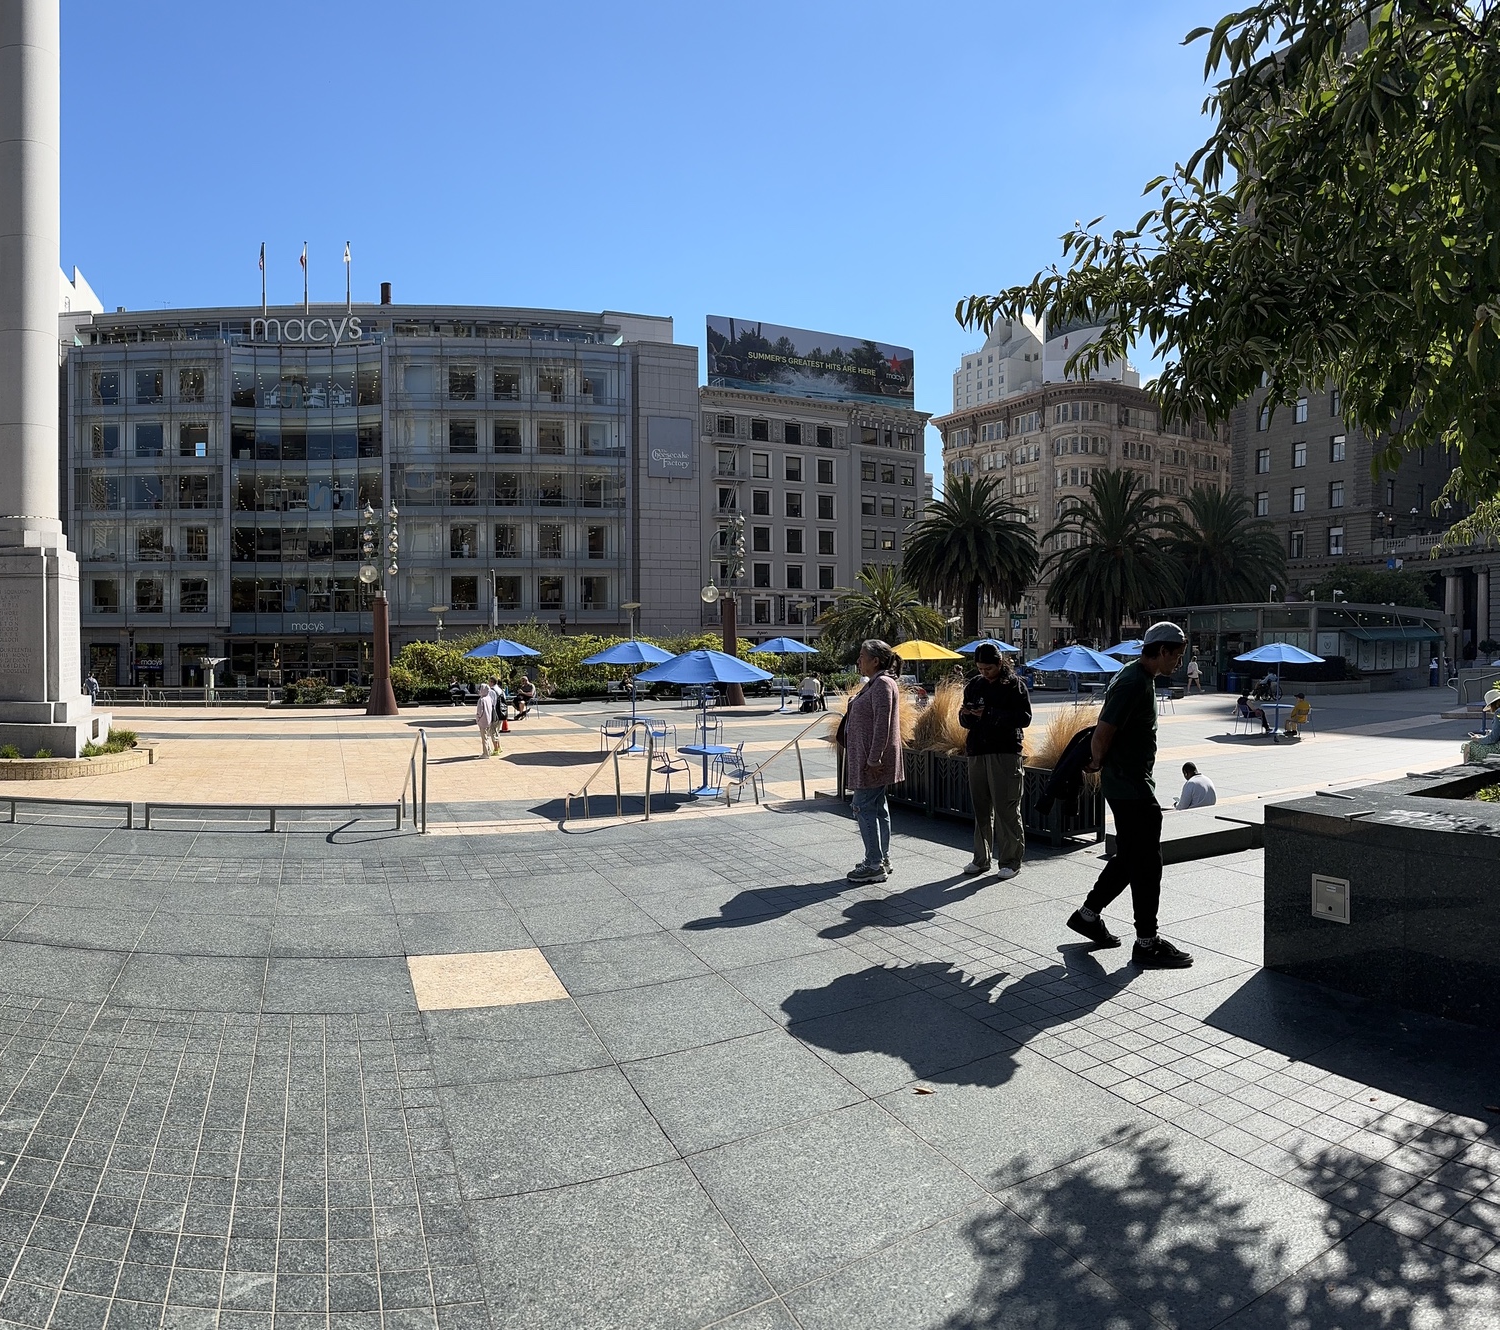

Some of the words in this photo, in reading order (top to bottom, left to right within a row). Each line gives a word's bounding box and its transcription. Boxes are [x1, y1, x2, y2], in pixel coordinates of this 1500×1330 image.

[748, 351, 787, 363] SUMMER'S
[788, 357, 824, 369] GREATEST
[825, 362, 841, 371] HITS
[842, 365, 857, 374] ARE
[858, 368, 876, 377] HERE
[652, 448, 690, 461] Cheesecake
[660, 457, 690, 469] Factory
[291, 620, 325, 632] macy's
